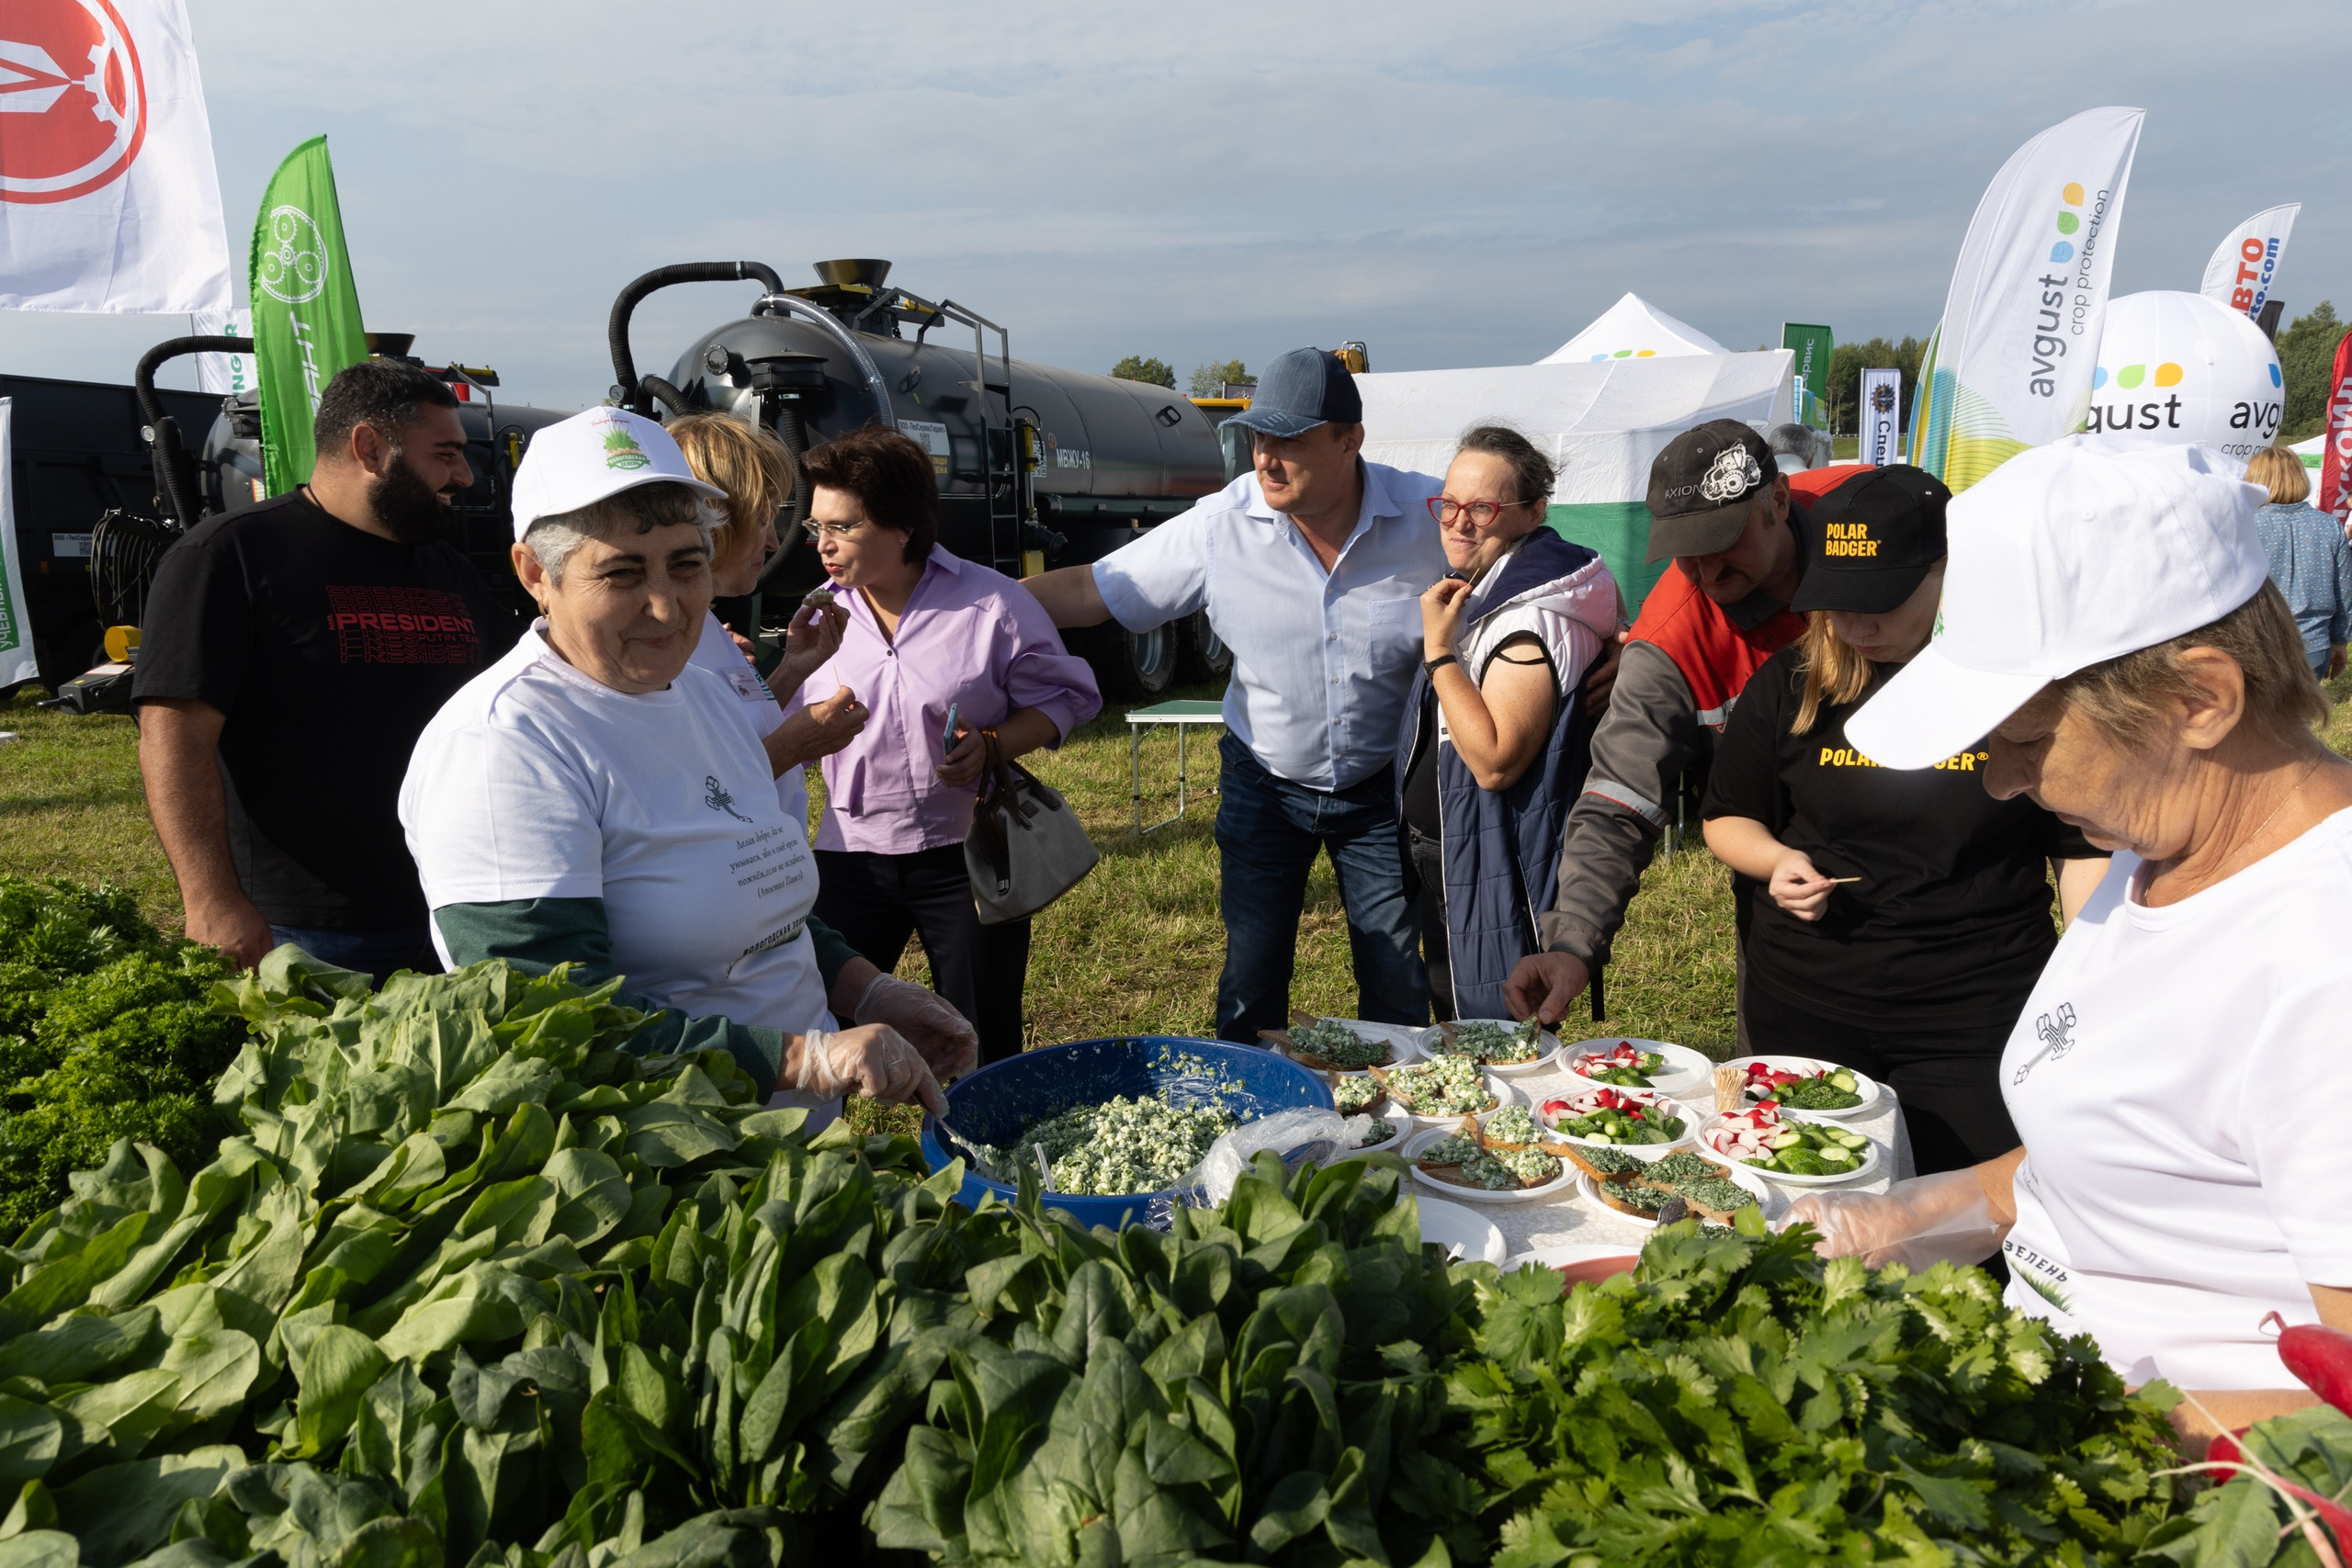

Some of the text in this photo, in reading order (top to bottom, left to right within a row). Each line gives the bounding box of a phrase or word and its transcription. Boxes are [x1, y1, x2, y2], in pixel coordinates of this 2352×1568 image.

[2072, 189, 2109, 335] crop protection
[2231, 238, 2264, 316] ВТО
[2030, 274, 2067, 397] avgust
[2086, 394, 2182, 434] gust
[1056, 448, 1091, 469] МВЖУ-16
[2221, 443, 2251, 459] crop
[1665, 484, 1703, 499] AXION
[1826, 523, 1868, 539] POLAR
[335, 613, 476, 635] PRESIDENT
[419, 633, 456, 642] PUTIN
[742, 923, 790, 956] ВОЛОГОДСКАЯ
[2004, 1240, 2068, 1282] ЗЕЛЕНЬ
